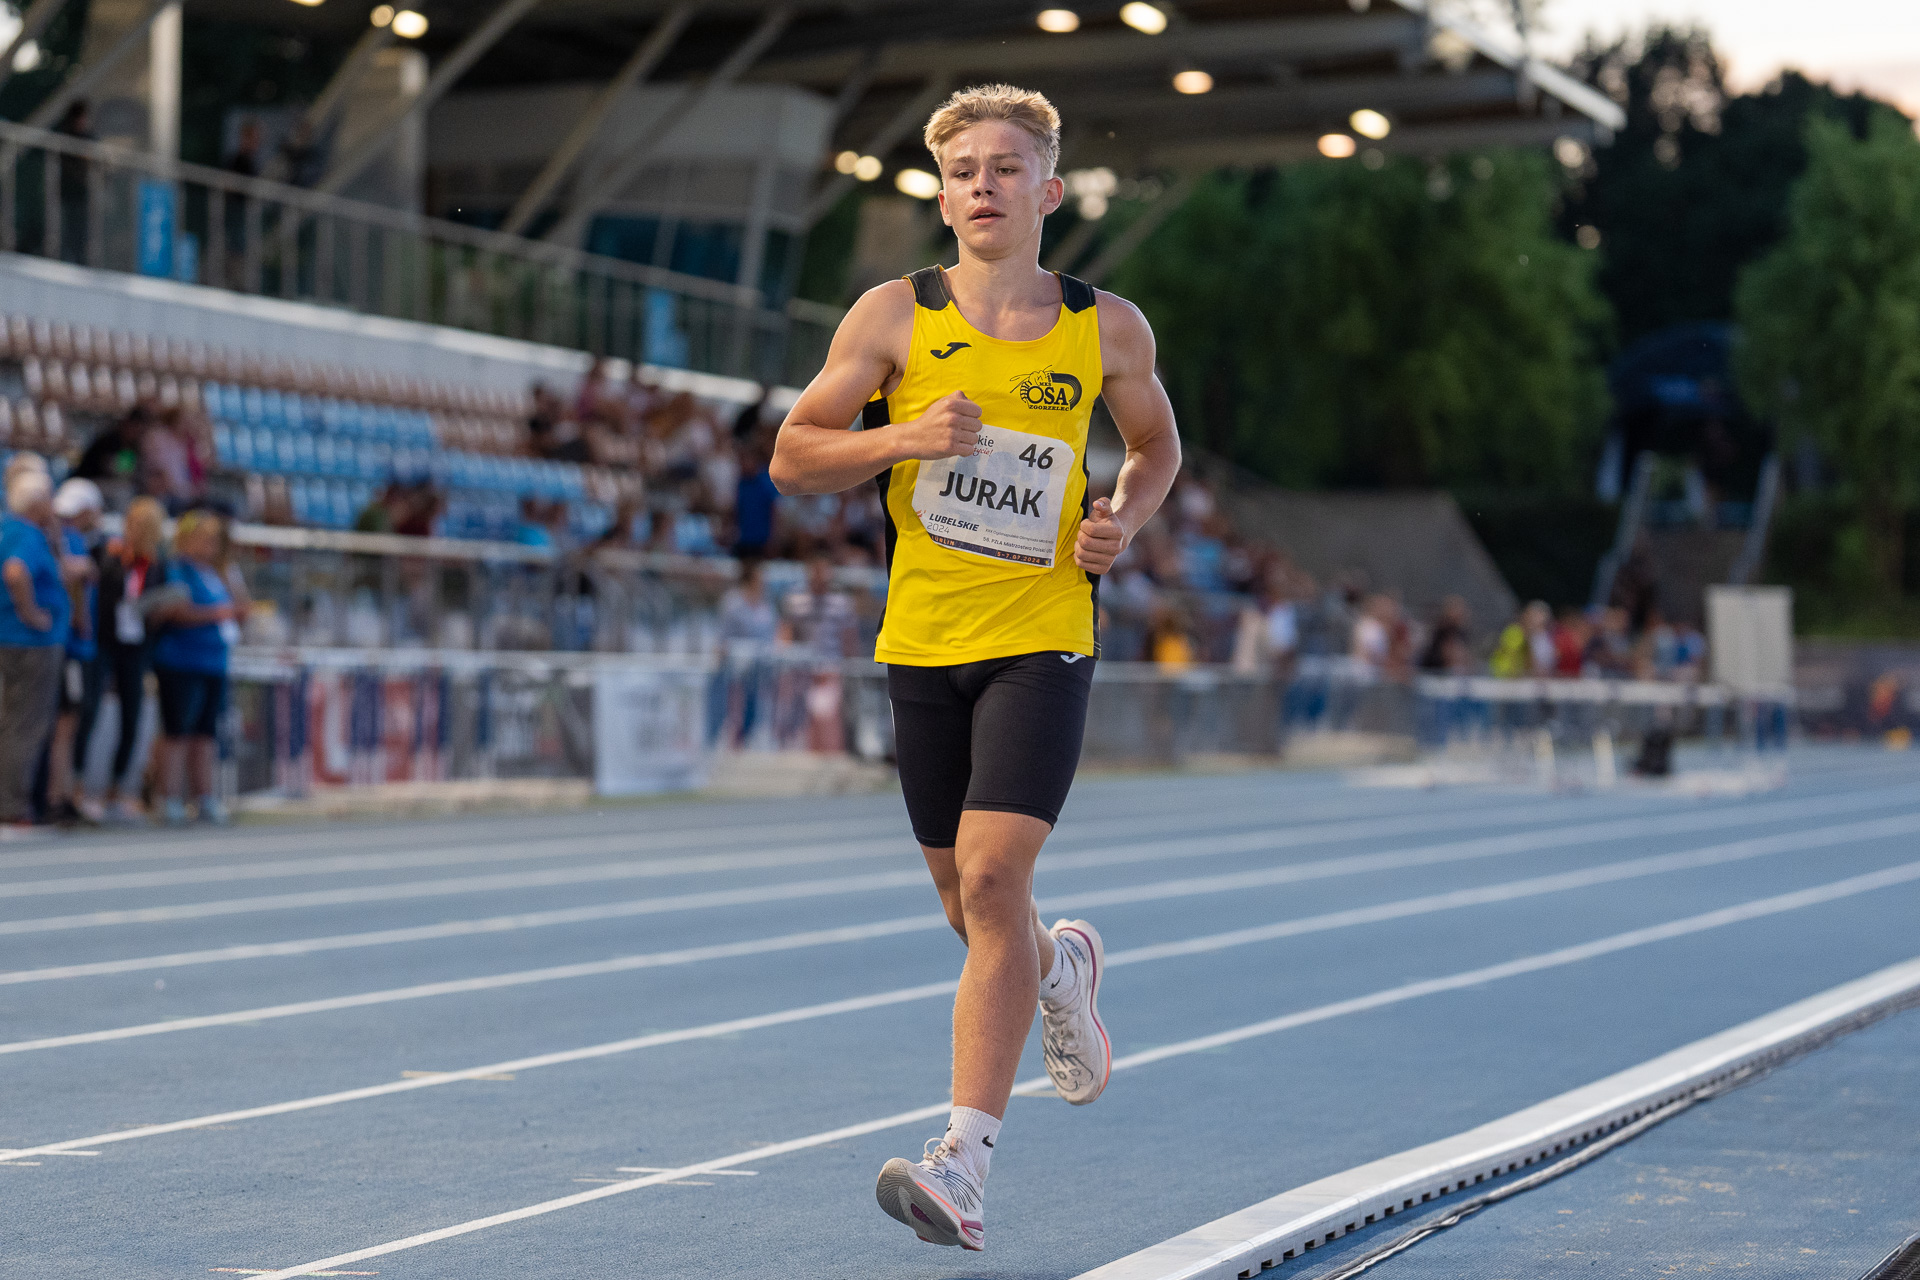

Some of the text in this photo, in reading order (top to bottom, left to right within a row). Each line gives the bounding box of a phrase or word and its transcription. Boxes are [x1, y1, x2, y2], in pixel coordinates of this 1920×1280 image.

[1027, 386, 1068, 405] OSA
[1019, 443, 1055, 469] 46
[939, 471, 1043, 517] JURAK
[927, 522, 949, 534] 2024
[929, 513, 979, 531] LUBELSKIE
